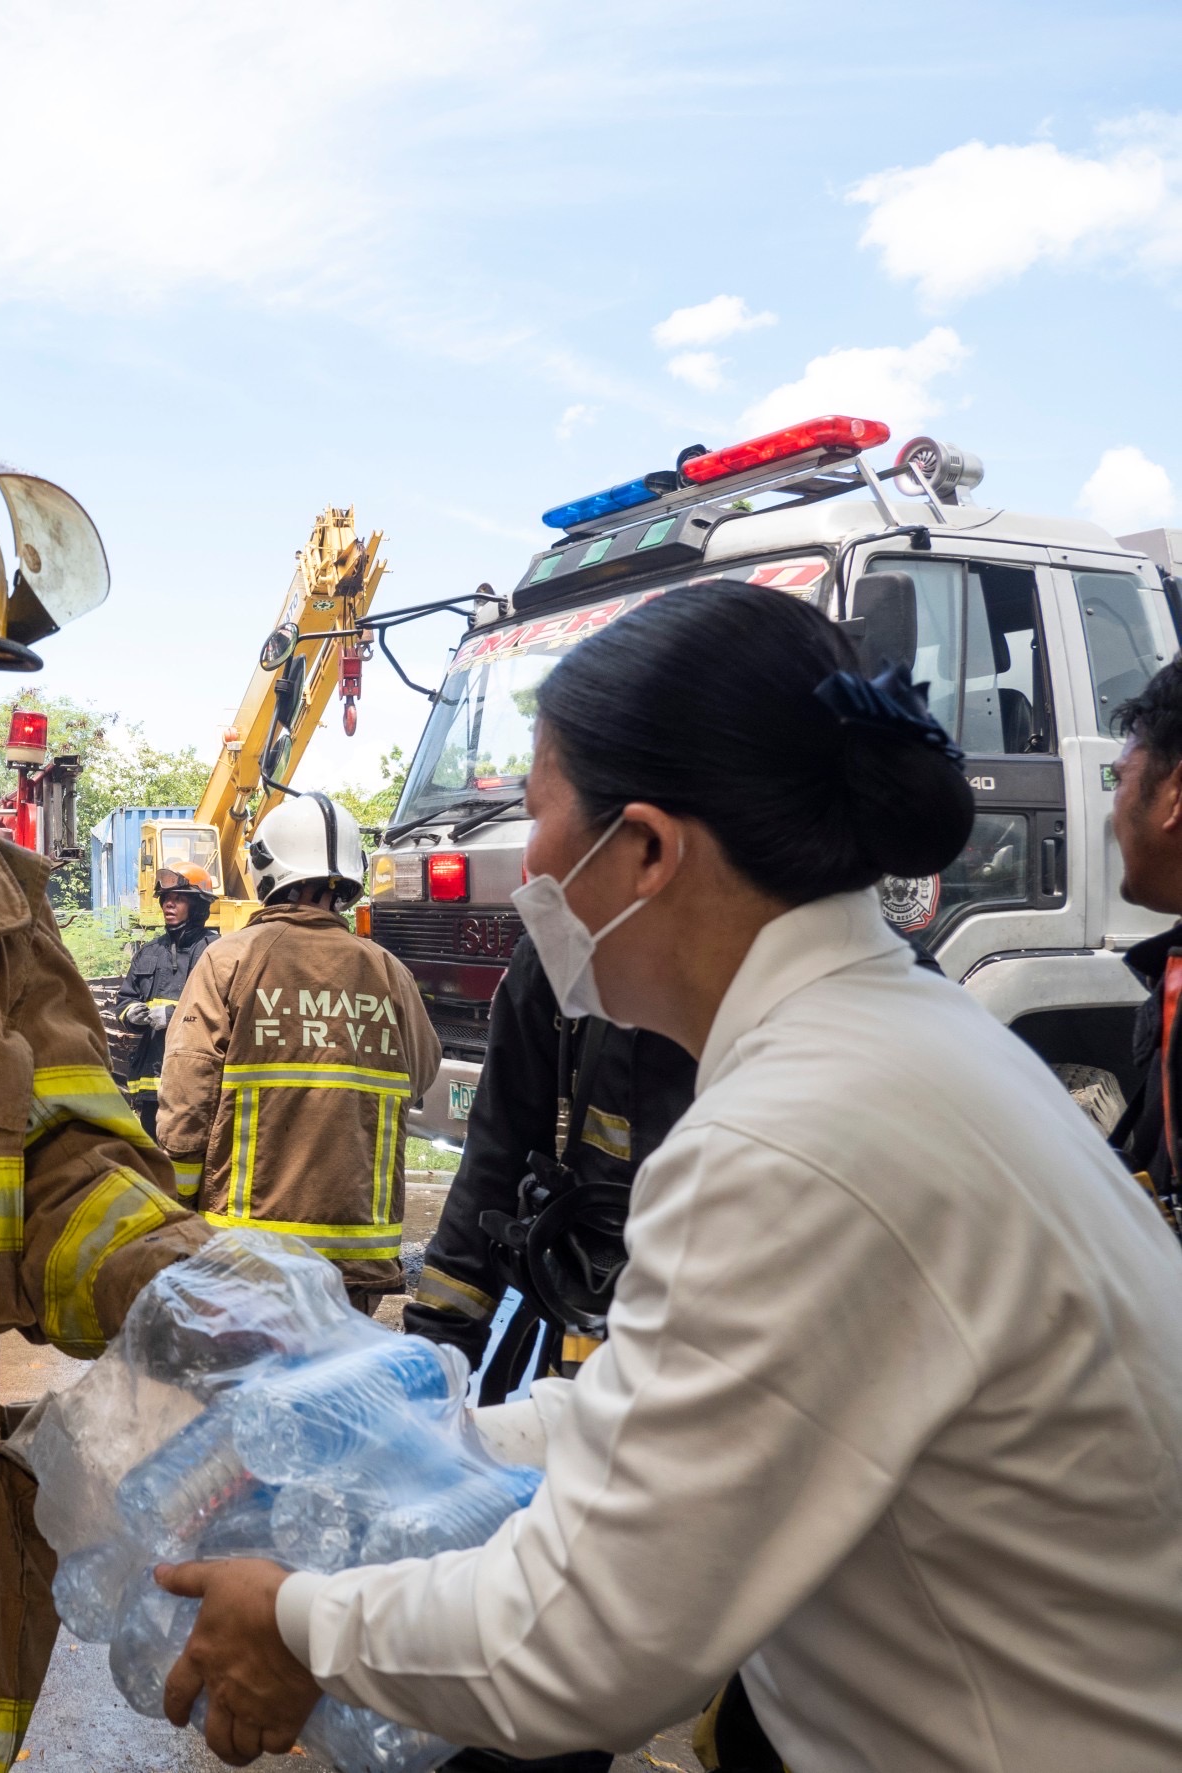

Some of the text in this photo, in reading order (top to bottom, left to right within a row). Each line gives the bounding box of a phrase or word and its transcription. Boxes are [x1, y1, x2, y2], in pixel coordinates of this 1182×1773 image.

[965, 776, 995, 790] 40
[256, 988, 397, 1025] V. MAPA
[255, 1019, 398, 1055] F. R. V. I.
